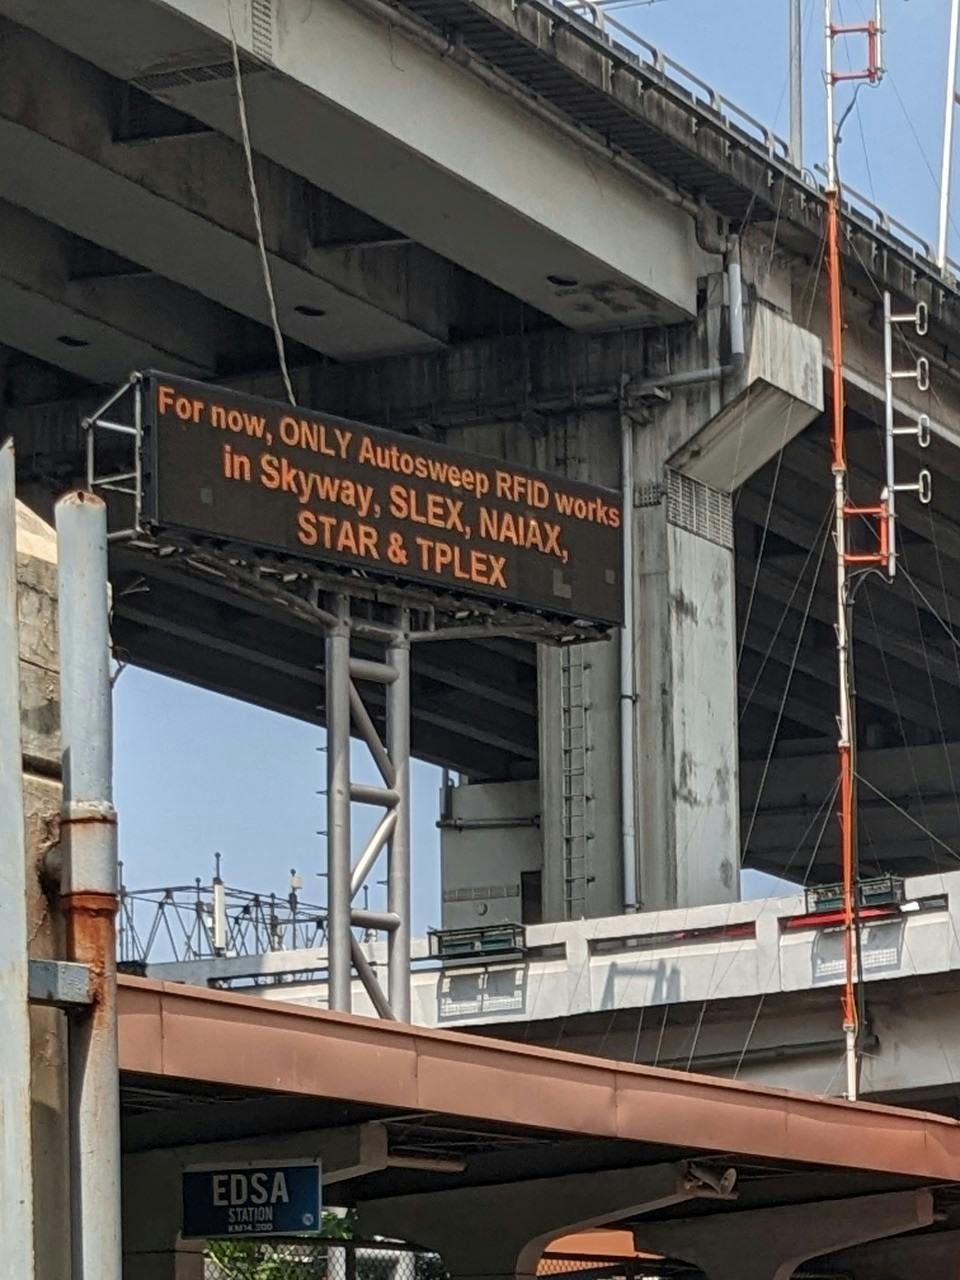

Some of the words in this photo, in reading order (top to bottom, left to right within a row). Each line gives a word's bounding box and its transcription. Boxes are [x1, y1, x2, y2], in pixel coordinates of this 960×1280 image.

[158, 385, 204, 424] For
[210, 405, 274, 446] now,
[279, 416, 351, 459] ONLY
[358, 436, 490, 498] Autosweep
[496, 470, 549, 509] RFID
[554, 492, 621, 528] works
[223, 443, 251, 481] in
[260, 452, 381, 518] Skyway,
[389, 485, 471, 540] SLEX,
[479, 506, 569, 564] NAIAX,
[297, 510, 380, 560] STAR
[387, 532, 408, 565] &
[416, 536, 508, 588] TPLEX
[212, 1171, 289, 1206] EDSA
[228, 1206, 273, 1223] STATION
